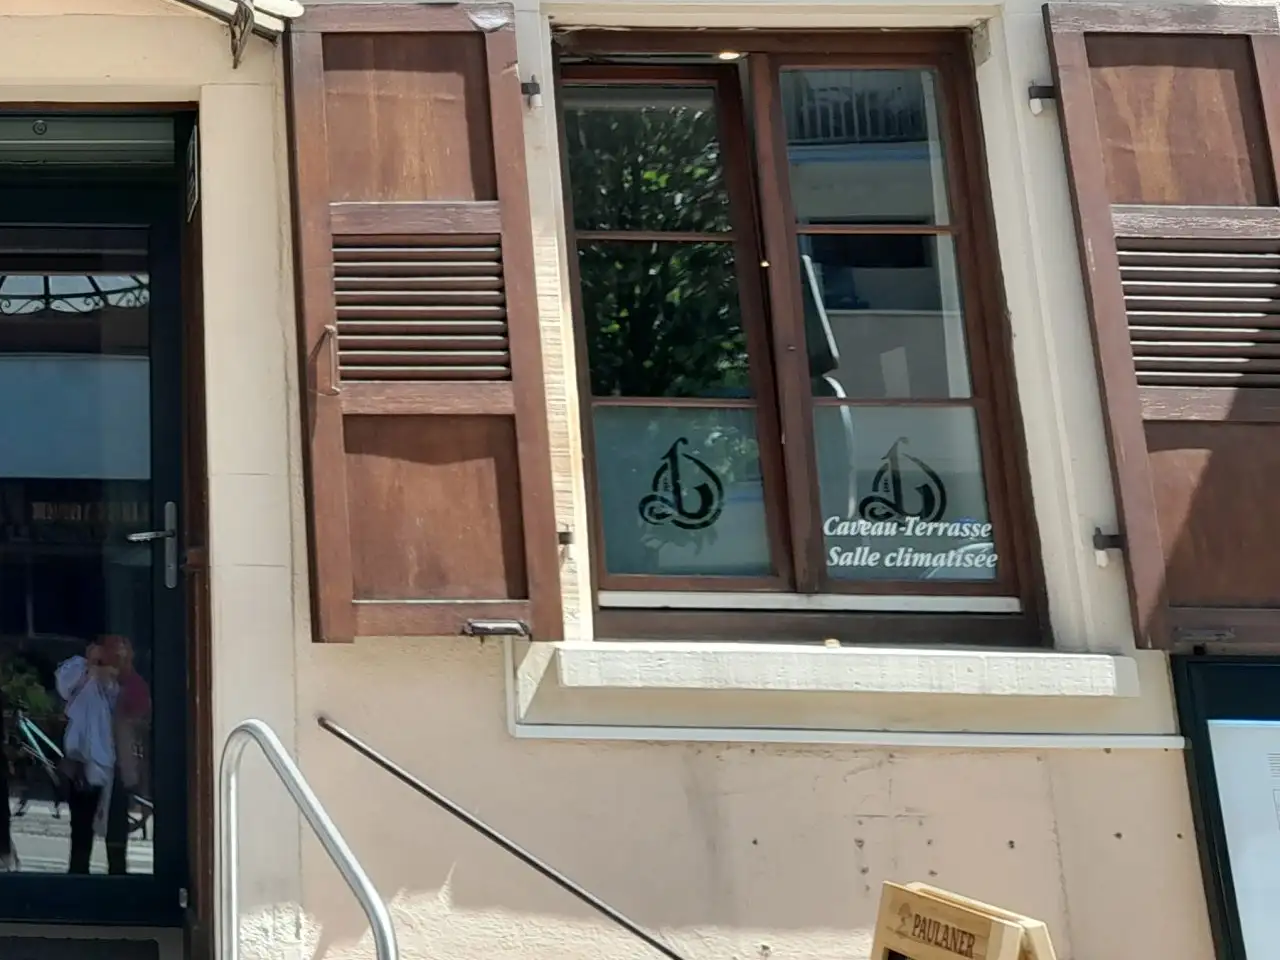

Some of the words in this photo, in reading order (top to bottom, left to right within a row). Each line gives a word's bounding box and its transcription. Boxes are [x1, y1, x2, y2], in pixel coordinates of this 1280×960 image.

[823, 515, 992, 538] Caveau-Terrasse
[827, 546, 881, 567] Salle
[912, 913, 975, 958] PAULANER
